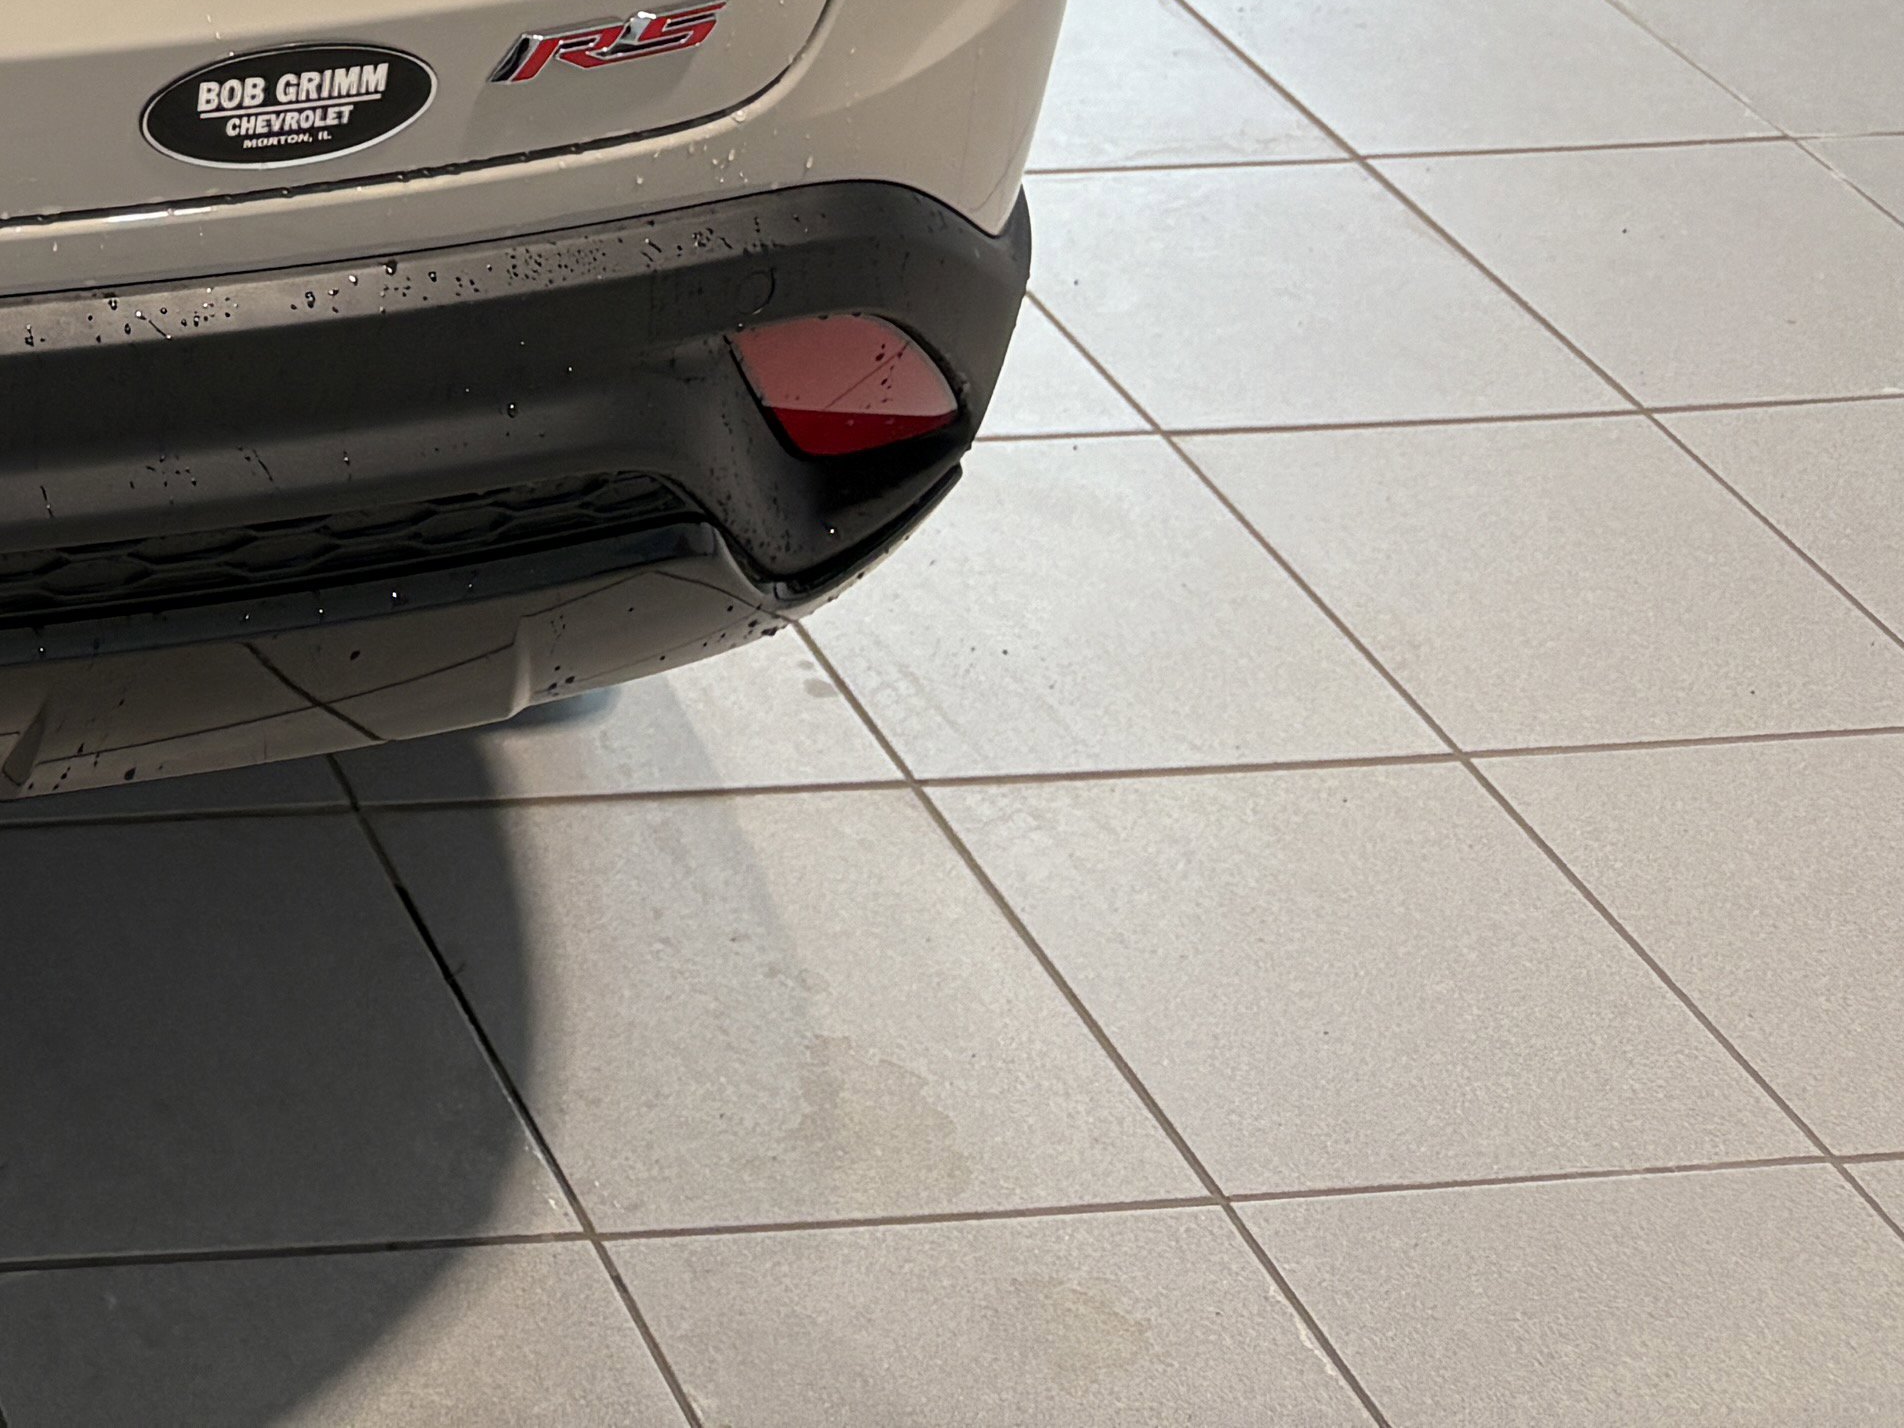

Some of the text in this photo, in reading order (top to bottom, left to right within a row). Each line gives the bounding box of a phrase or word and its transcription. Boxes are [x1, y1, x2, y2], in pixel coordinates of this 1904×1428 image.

[196, 62, 390, 112] BOB GRIMM
[225, 104, 355, 137] CHEVROLET
[242, 131, 313, 149] MORTON,
